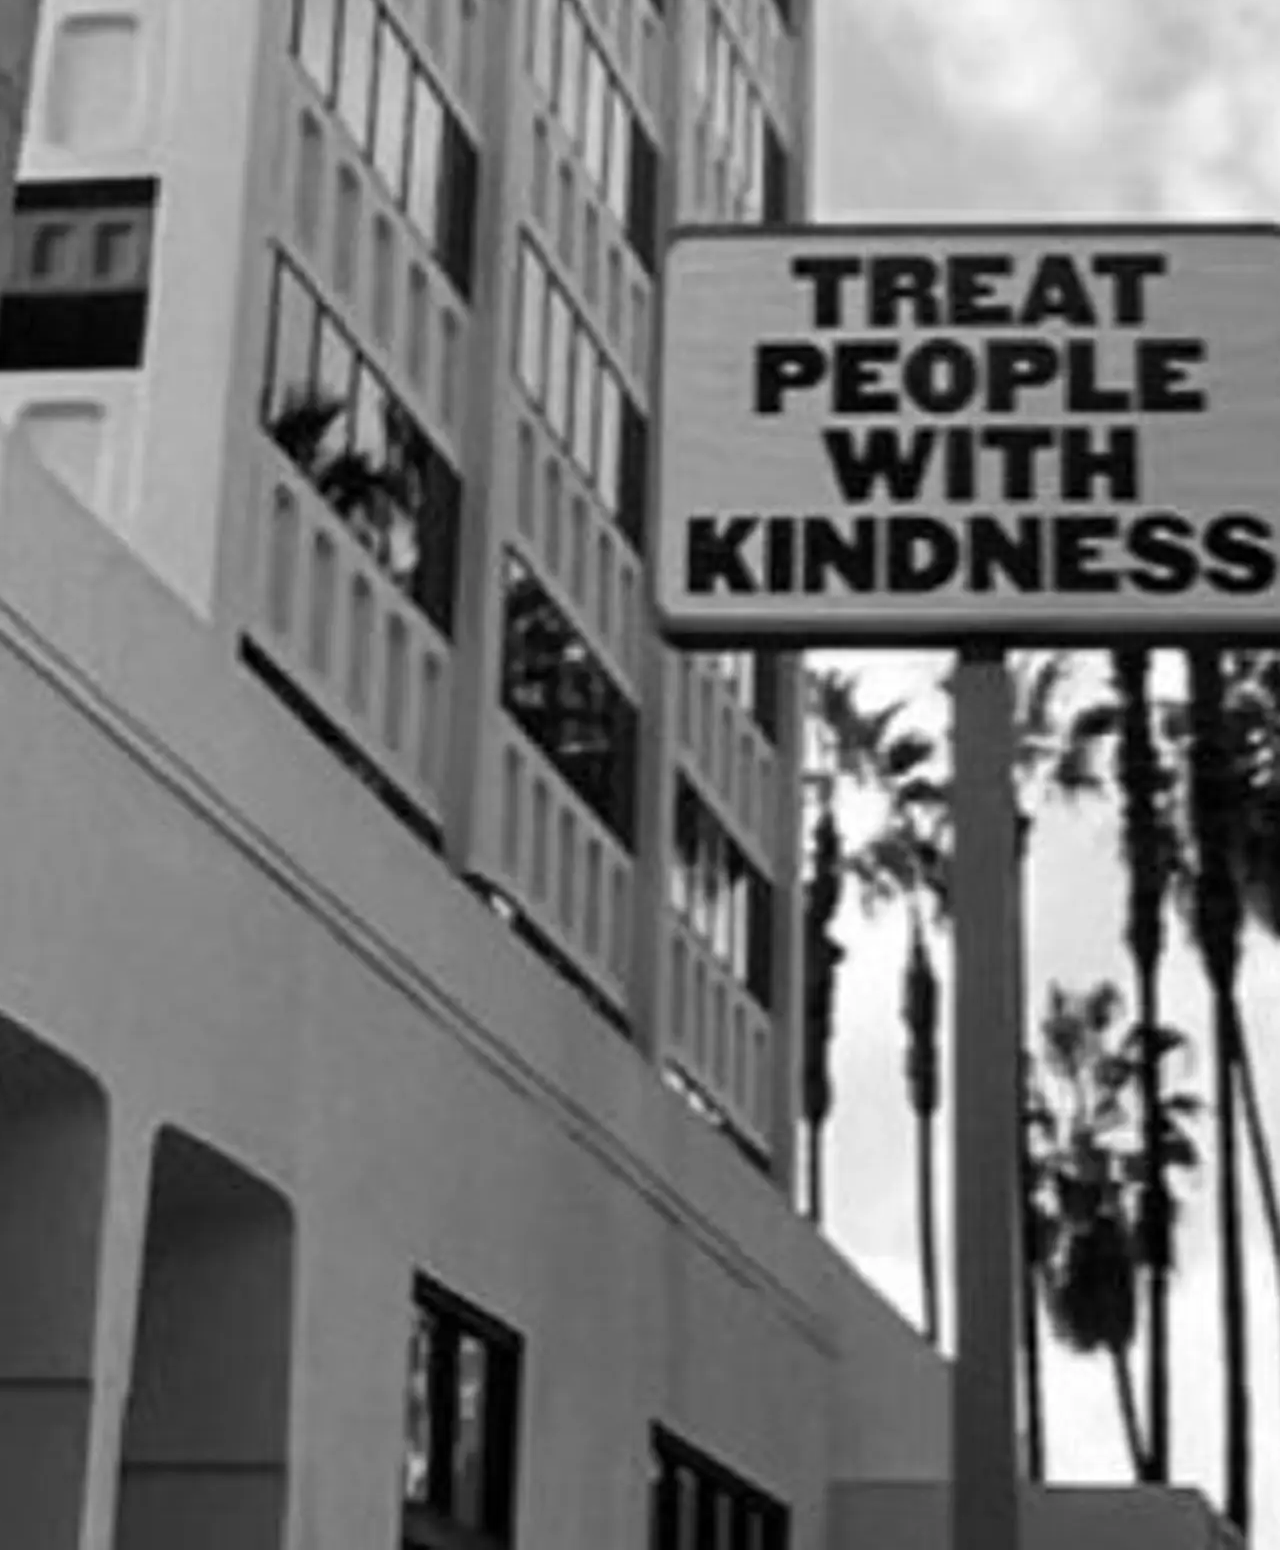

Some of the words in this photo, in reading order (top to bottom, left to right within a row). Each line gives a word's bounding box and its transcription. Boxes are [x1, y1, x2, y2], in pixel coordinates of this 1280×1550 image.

[790, 253, 1167, 329] TREAT
[753, 338, 1208, 415] PEOPLE
[821, 425, 1140, 504] WITH
[685, 513, 1279, 595] KINDNESS
